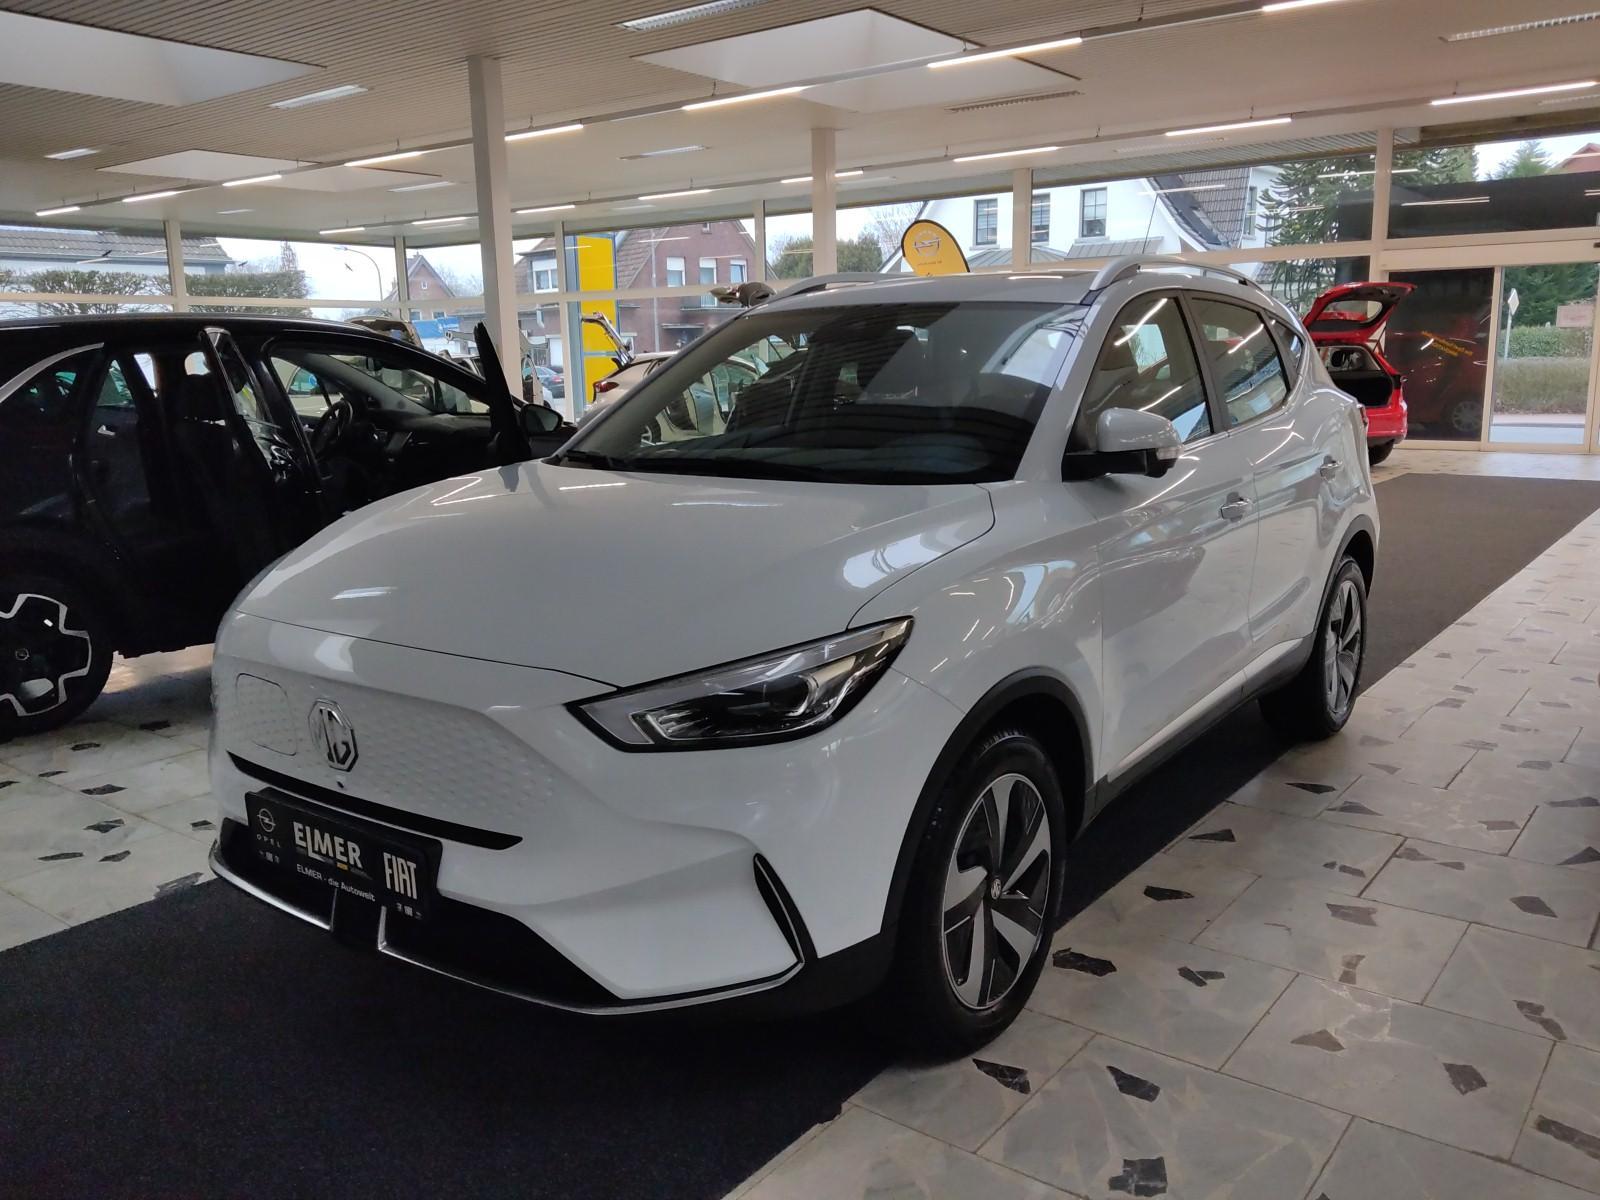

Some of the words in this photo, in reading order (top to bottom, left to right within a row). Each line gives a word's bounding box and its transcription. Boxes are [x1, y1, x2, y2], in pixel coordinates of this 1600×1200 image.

[311, 702, 355, 768] MG
[256, 833, 281, 848] OPEL
[293, 821, 363, 869] ELMER
[296, 863, 323, 880] ELMER
[340, 881, 376, 902] Autowelt
[383, 851, 418, 900] FIAT
